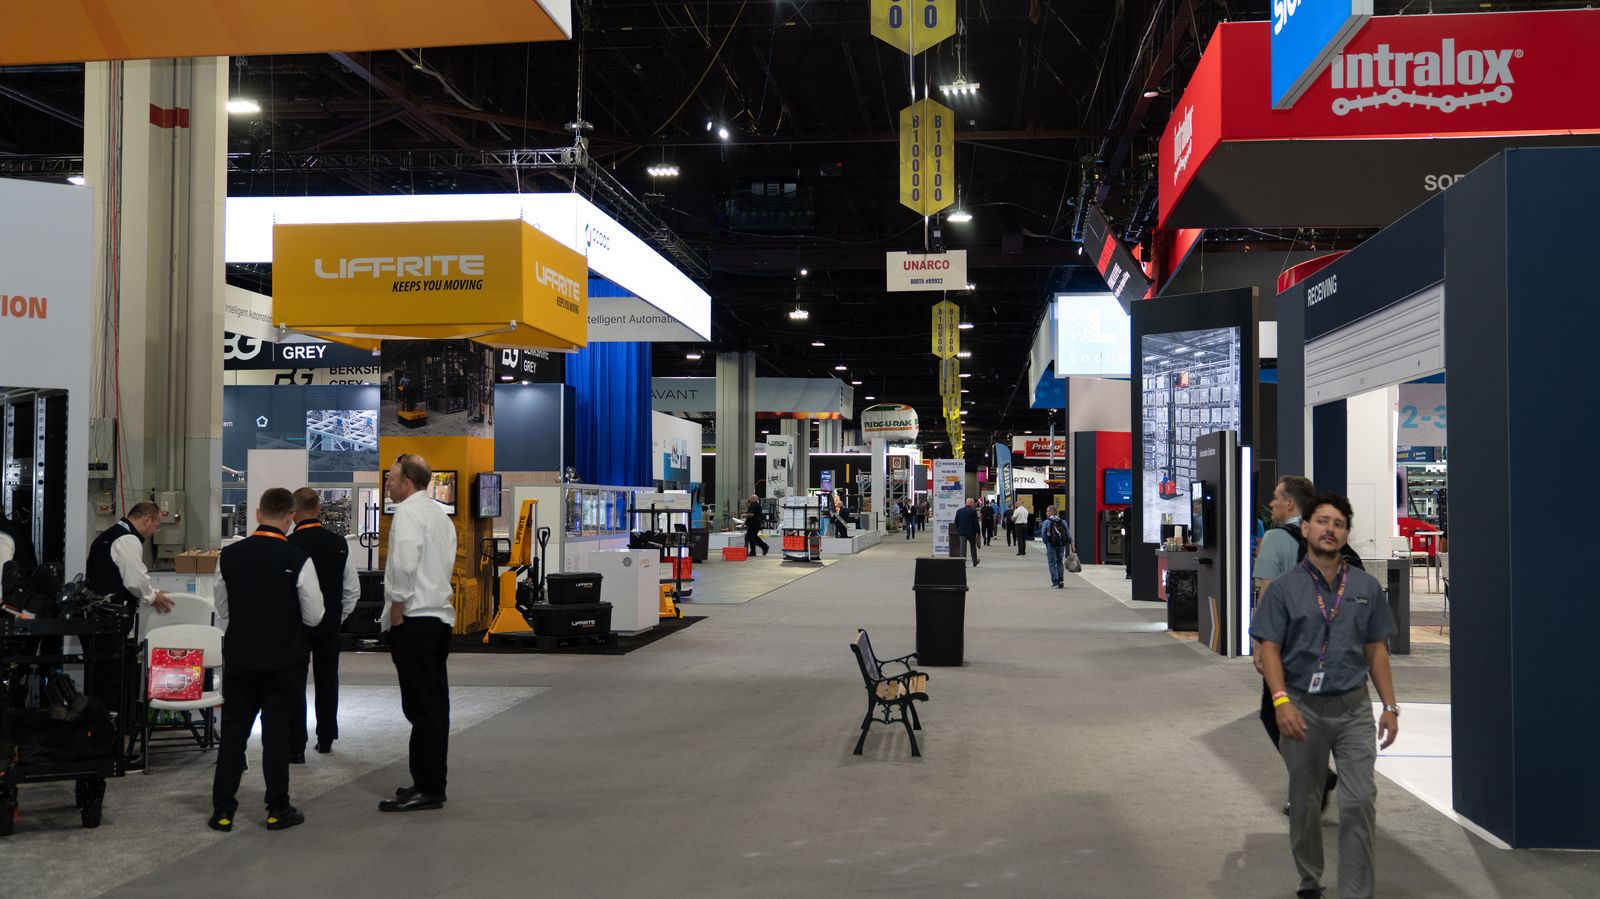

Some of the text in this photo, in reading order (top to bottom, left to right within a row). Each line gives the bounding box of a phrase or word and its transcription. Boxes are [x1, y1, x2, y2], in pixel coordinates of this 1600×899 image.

[934, 115, 942, 202] B10100
[903, 260, 950, 271] UNARCO
[392, 279, 483, 292] KEEPS YOU MOVING
[1307, 274, 1337, 307] RECEIVING
[283, 345, 326, 359] GREY
[524, 360, 537, 373] GREY
